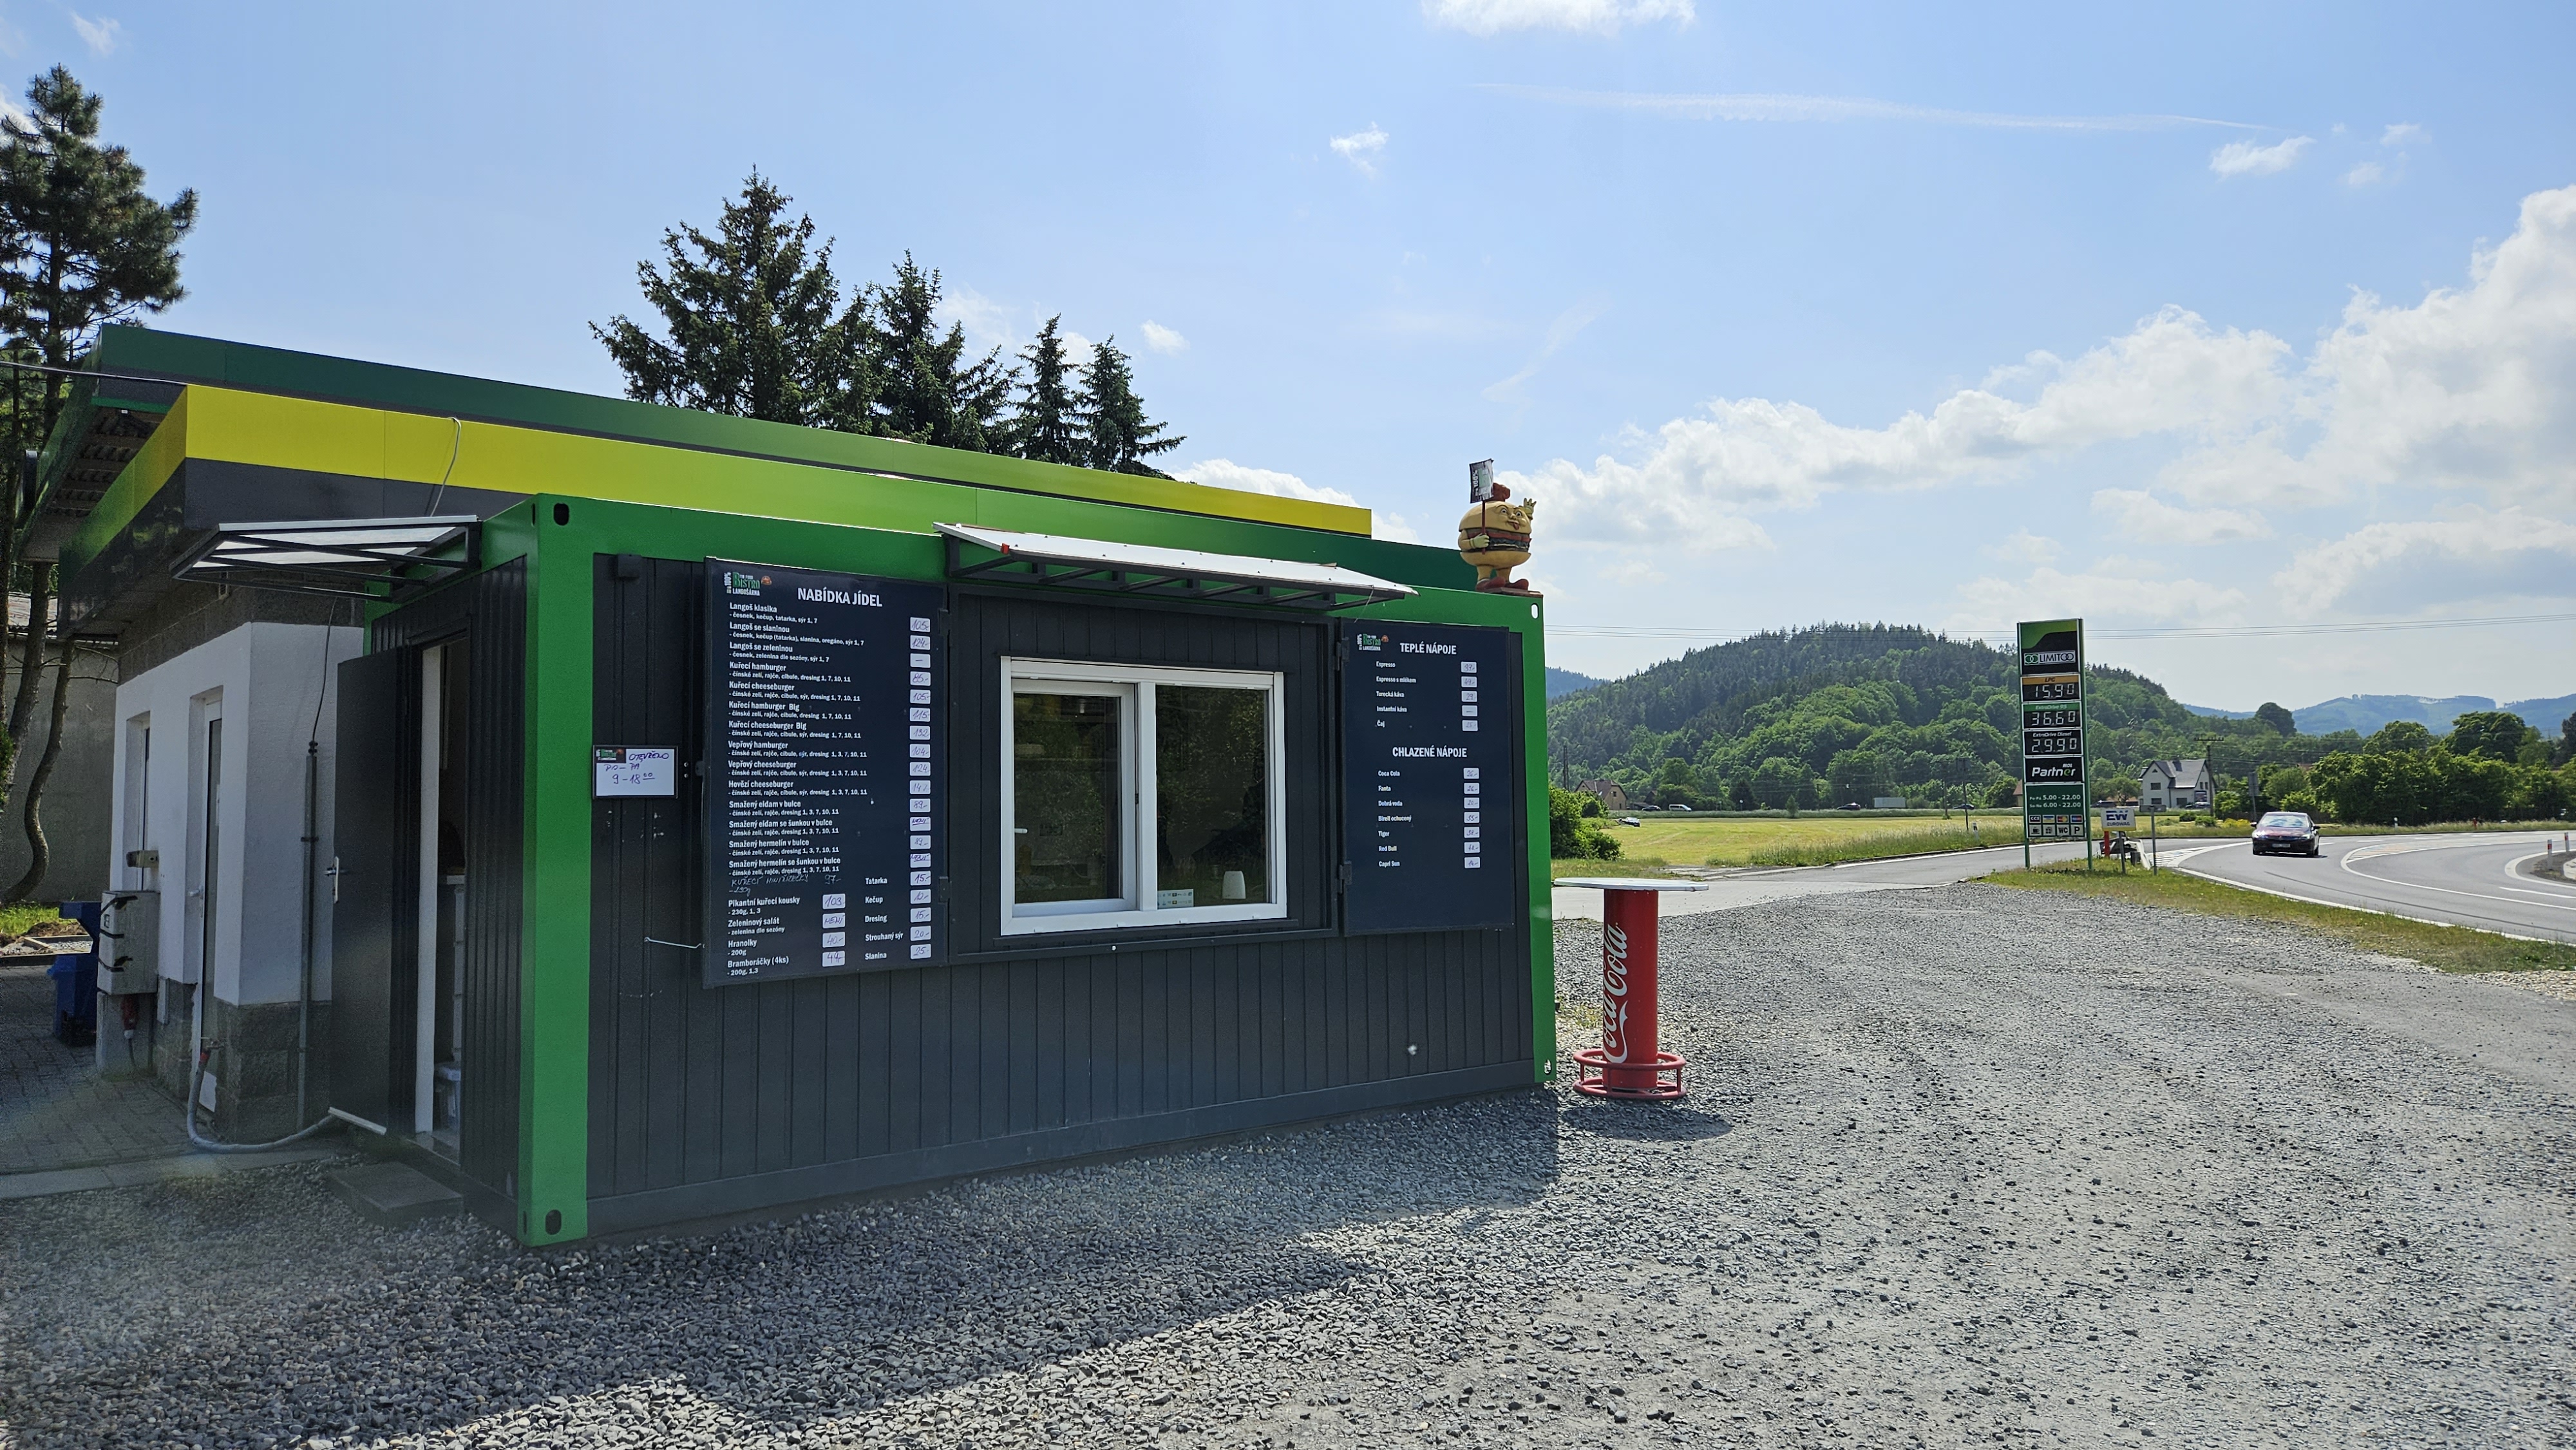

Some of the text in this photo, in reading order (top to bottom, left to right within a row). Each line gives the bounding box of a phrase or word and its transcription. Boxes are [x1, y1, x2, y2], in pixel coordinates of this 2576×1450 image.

[797, 587, 882, 607] NABÍDKA JÍDEL
[729, 602, 777, 612] Langoš klasika
[732, 611, 755, 619] česnek,
[729, 621, 753, 631] Langoš
[762, 624, 790, 633] slaninou
[729, 641, 753, 651] Langoš
[762, 644, 793, 652] zeleninou
[1399, 641, 1457, 654] TEPLÉ NÁPOJE
[752, 662, 786, 672] hamburger
[729, 681, 795, 692] Kuřecí cheeseburger
[751, 701, 786, 711] hamburger
[788, 703, 799, 712] Big
[1376, 719, 1385, 728] Čaj
[2032, 711, 2076, 726] 36.60
[750, 721, 793, 730] cheeseburger
[796, 722, 807, 731] Big
[728, 740, 788, 750] Vepřový hamburger
[2031, 738, 2077, 753] 29.90
[1392, 744, 1467, 757] CHLAZENÉ NÁPOJE
[728, 760, 797, 769] Vepřový cheeseburger
[2032, 767, 2076, 777] Partner
[750, 780, 793, 789] cheeseburger
[729, 800, 758, 809] Smažený
[728, 820, 758, 829] Smažený
[728, 840, 758, 849] Smažený
[729, 860, 758, 869] Smažený
[728, 896, 800, 907] Pikantní kuřecí kousky
[865, 896, 883, 904] Kečup
[728, 916, 779, 927] Zeleninový salát
[865, 914, 887, 923] Dresing
[865, 931, 904, 941] Strouhaný sýr
[728, 938, 757, 948] Hranolky
[865, 952, 887, 960] Slanina
[728, 956, 789, 968] Bramboráčky (4ks)
